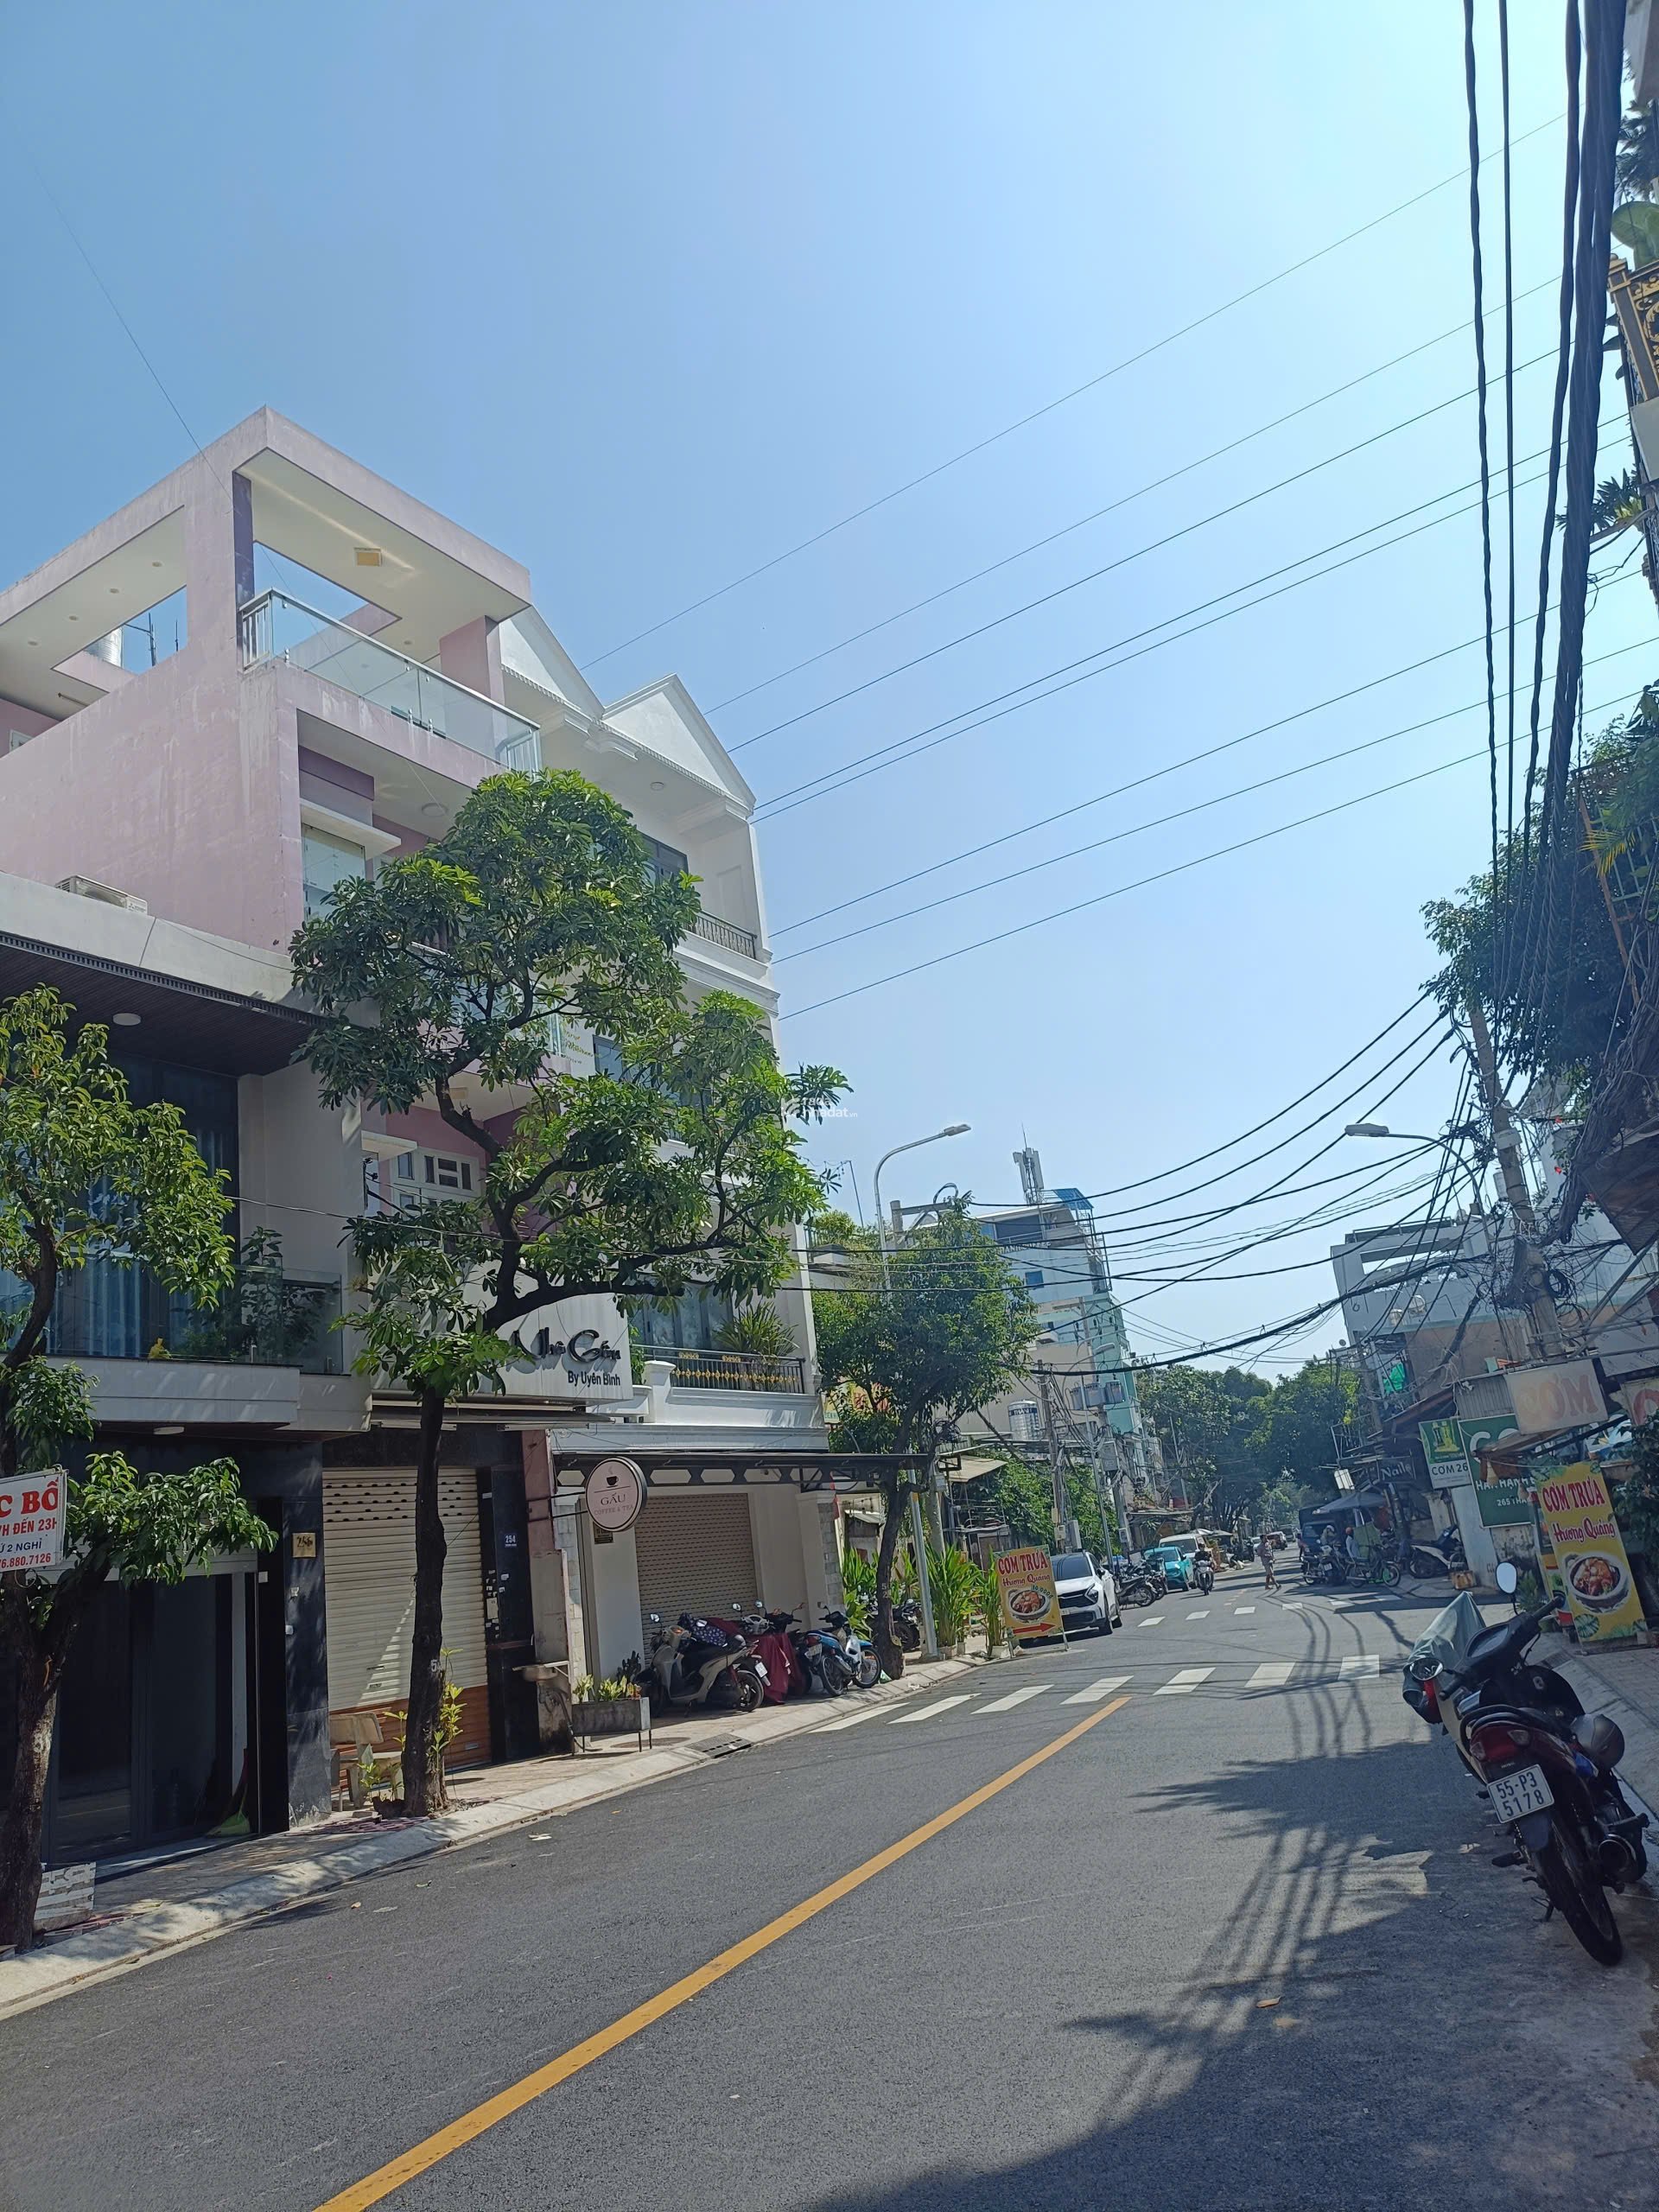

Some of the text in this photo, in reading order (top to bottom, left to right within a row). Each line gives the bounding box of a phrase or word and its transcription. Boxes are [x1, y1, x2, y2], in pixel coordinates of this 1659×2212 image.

[568, 1371, 579, 1387] By
[582, 1371, 601, 1388] Uyên
[601, 1492, 626, 1505] GẤU
[1497, 1498, 1511, 1507] 265
[1542, 1476, 1605, 1512] CƠM TRƯA
[13, 1517, 35, 1535] ĐẾN
[1552, 1522, 1585, 1542] Hương
[7, 1544, 13, 1553] 2
[16, 1538, 42, 1552] NGHỈ
[0, 1553, 52, 1569] 6.880.7126
[998, 1550, 1048, 1574] CƠM TRƯA
[1496, 1771, 1538, 1799] 55-P3
[1502, 1789, 1544, 1816] 5178
